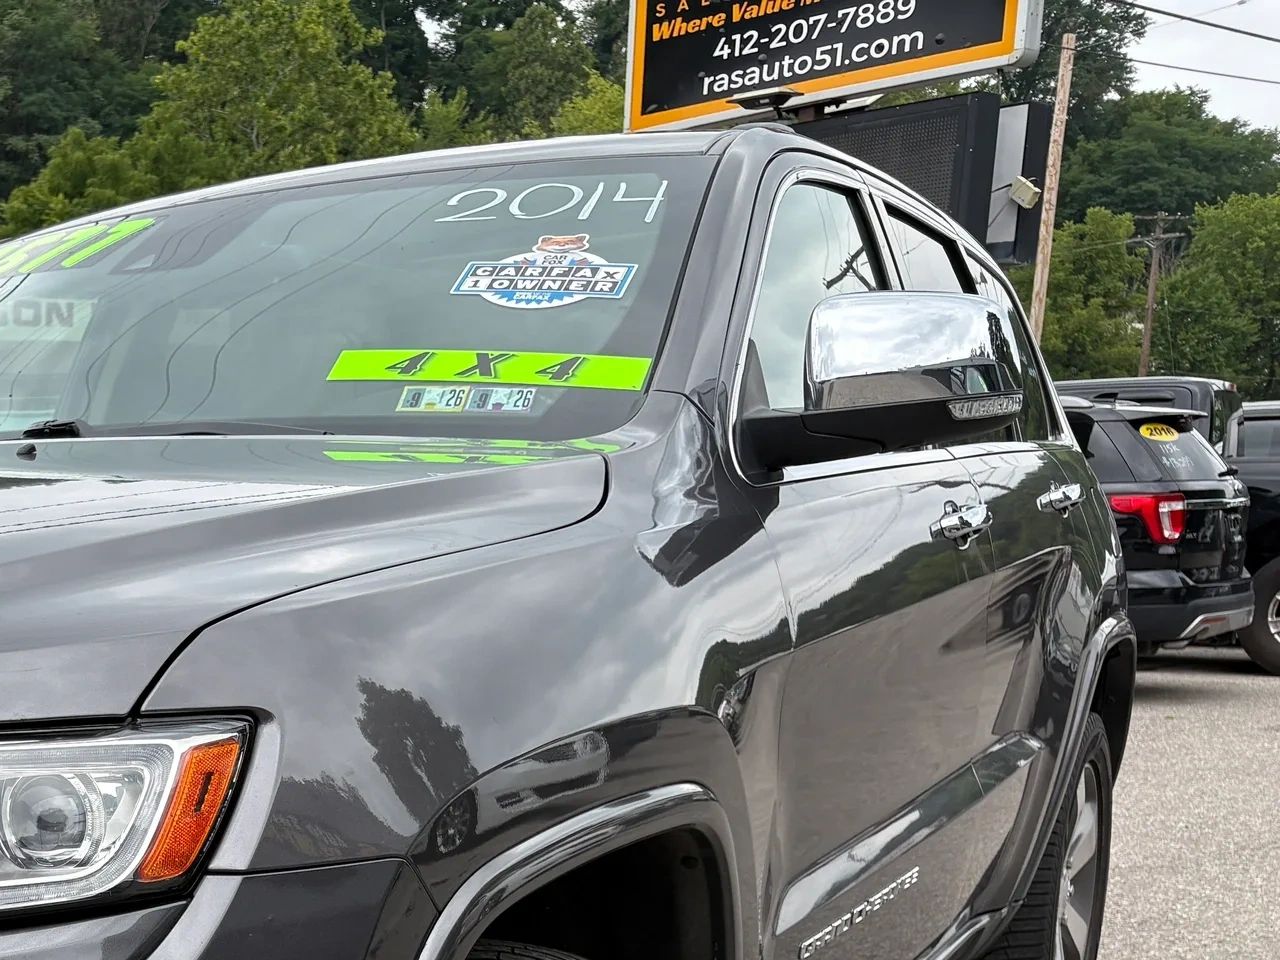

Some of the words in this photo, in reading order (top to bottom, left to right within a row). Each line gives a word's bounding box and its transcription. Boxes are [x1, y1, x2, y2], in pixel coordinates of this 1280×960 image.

[651, 11, 727, 42] Where
[732, 0, 796, 23] Value
[711, 0, 916, 61] 412-207-7889
[702, 30, 924, 96] rasauto51.com
[434, 180, 668, 223] 2014
[475, 266, 621, 281] CARFAX
[492, 279, 615, 292] OWNER
[384, 351, 435, 376] 4
[453, 352, 517, 379] X
[535, 356, 588, 382] 4
